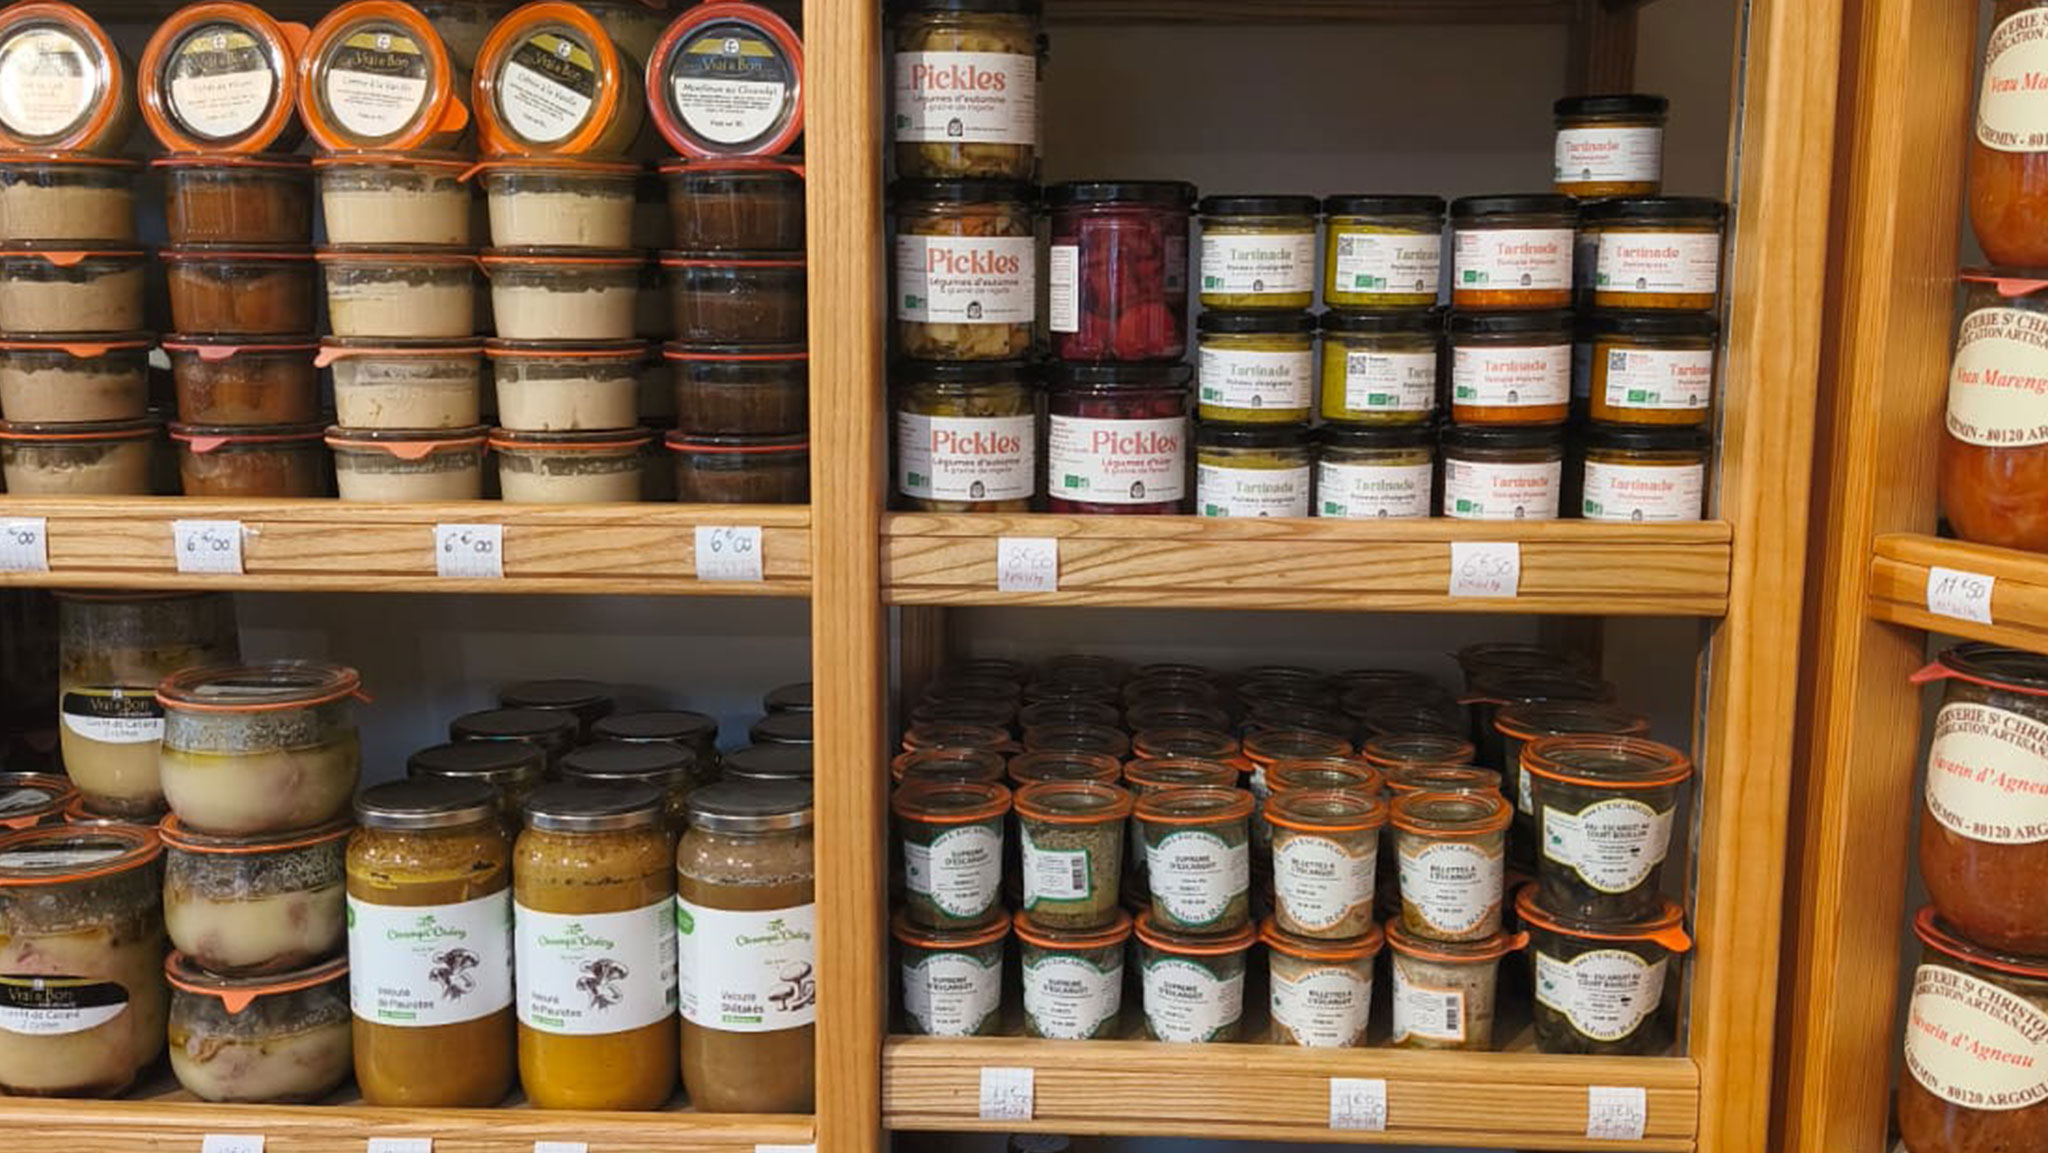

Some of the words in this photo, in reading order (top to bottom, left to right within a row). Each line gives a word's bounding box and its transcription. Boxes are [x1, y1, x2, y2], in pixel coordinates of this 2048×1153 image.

[910, 64, 1006, 91] Pickles
[1230, 247, 1293, 260] Tartinade
[1496, 241, 1558, 255] Tartinade
[1616, 246, 1680, 259] Tartinade
[926, 247, 1020, 274] Pickles
[1230, 363, 1291, 377] Tartinade
[1484, 360, 1547, 372] Tartinade
[931, 429, 1020, 454] Pickles
[1092, 430, 1178, 455] Pickles
[1354, 478, 1415, 492] Tartinade
[1492, 473, 1548, 487] Tartinade
[1610, 477, 1674, 491] Tartinade
[1236, 481, 1294, 494] Tartinade
[1972, 822, 2011, 838] 80120
[1947, 1084, 1983, 1103] 80120
